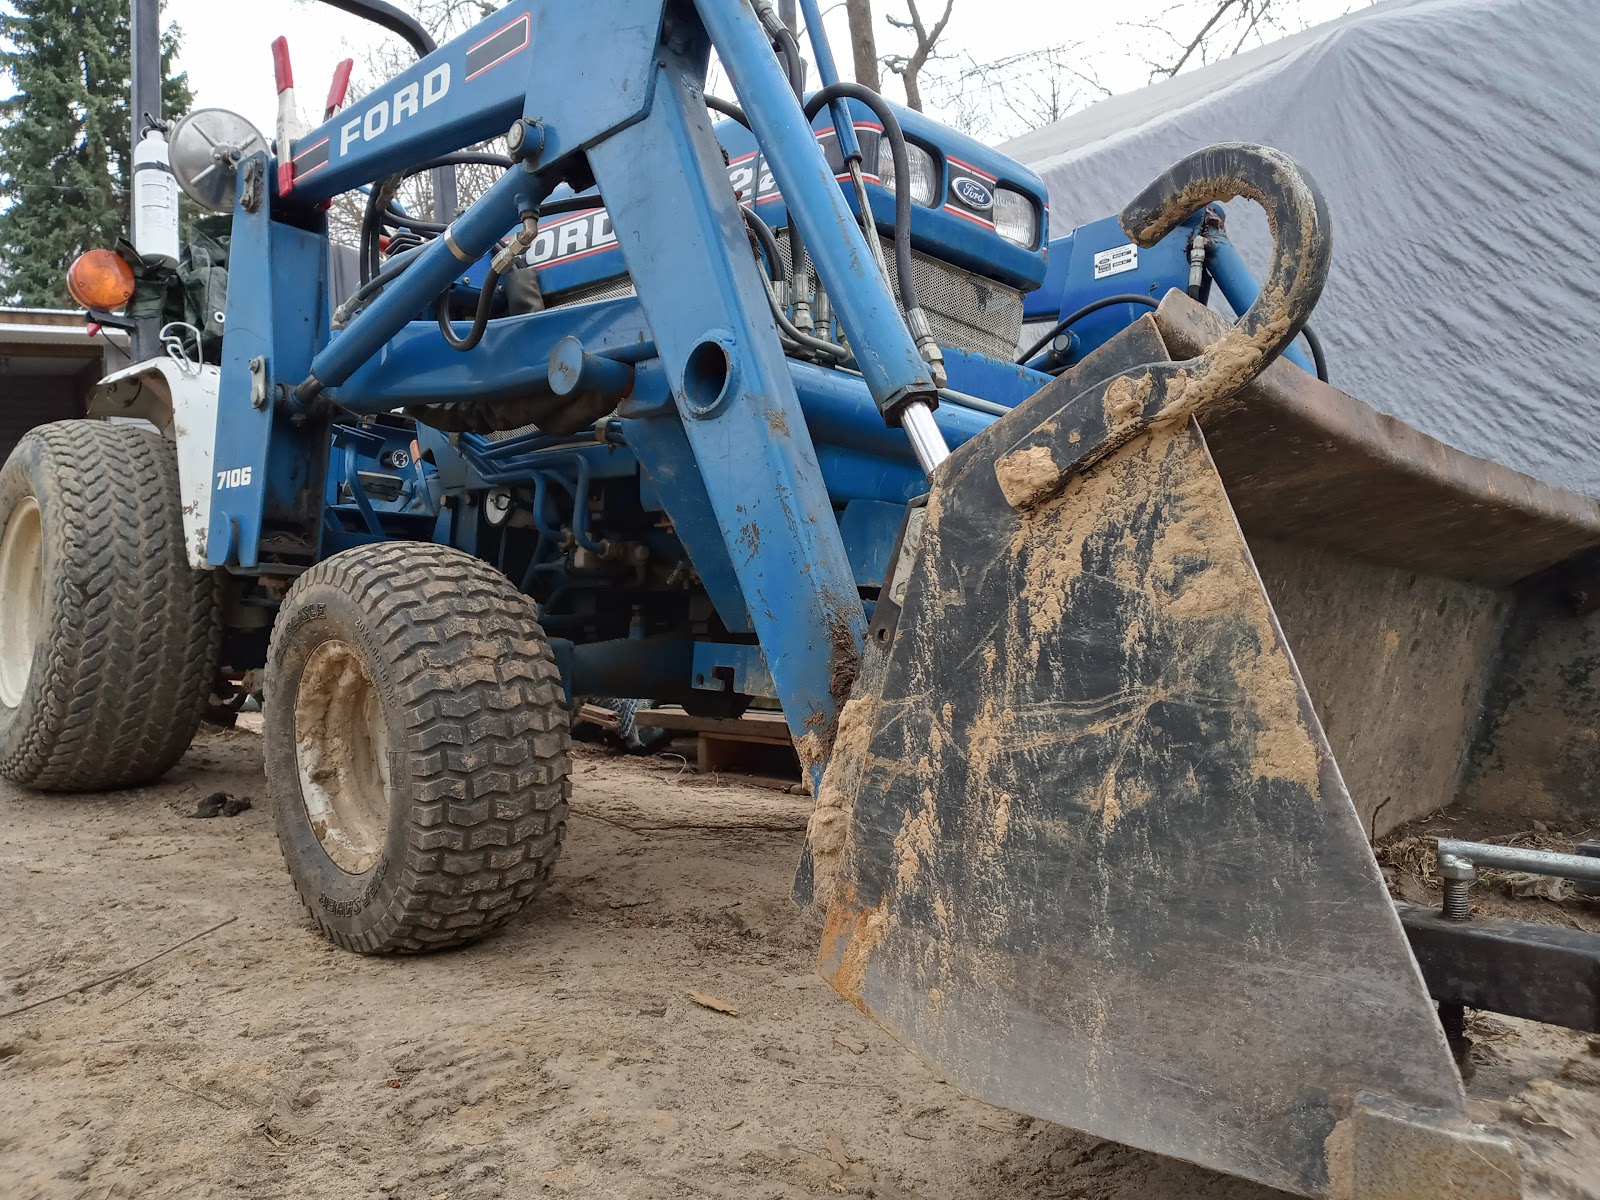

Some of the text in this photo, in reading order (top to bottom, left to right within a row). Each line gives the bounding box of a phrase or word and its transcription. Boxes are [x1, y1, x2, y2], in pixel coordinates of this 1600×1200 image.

[340, 62, 451, 157] FORD
[962, 182, 985, 203] Ford
[525, 211, 617, 265] ORD
[216, 466, 252, 491] 7106
